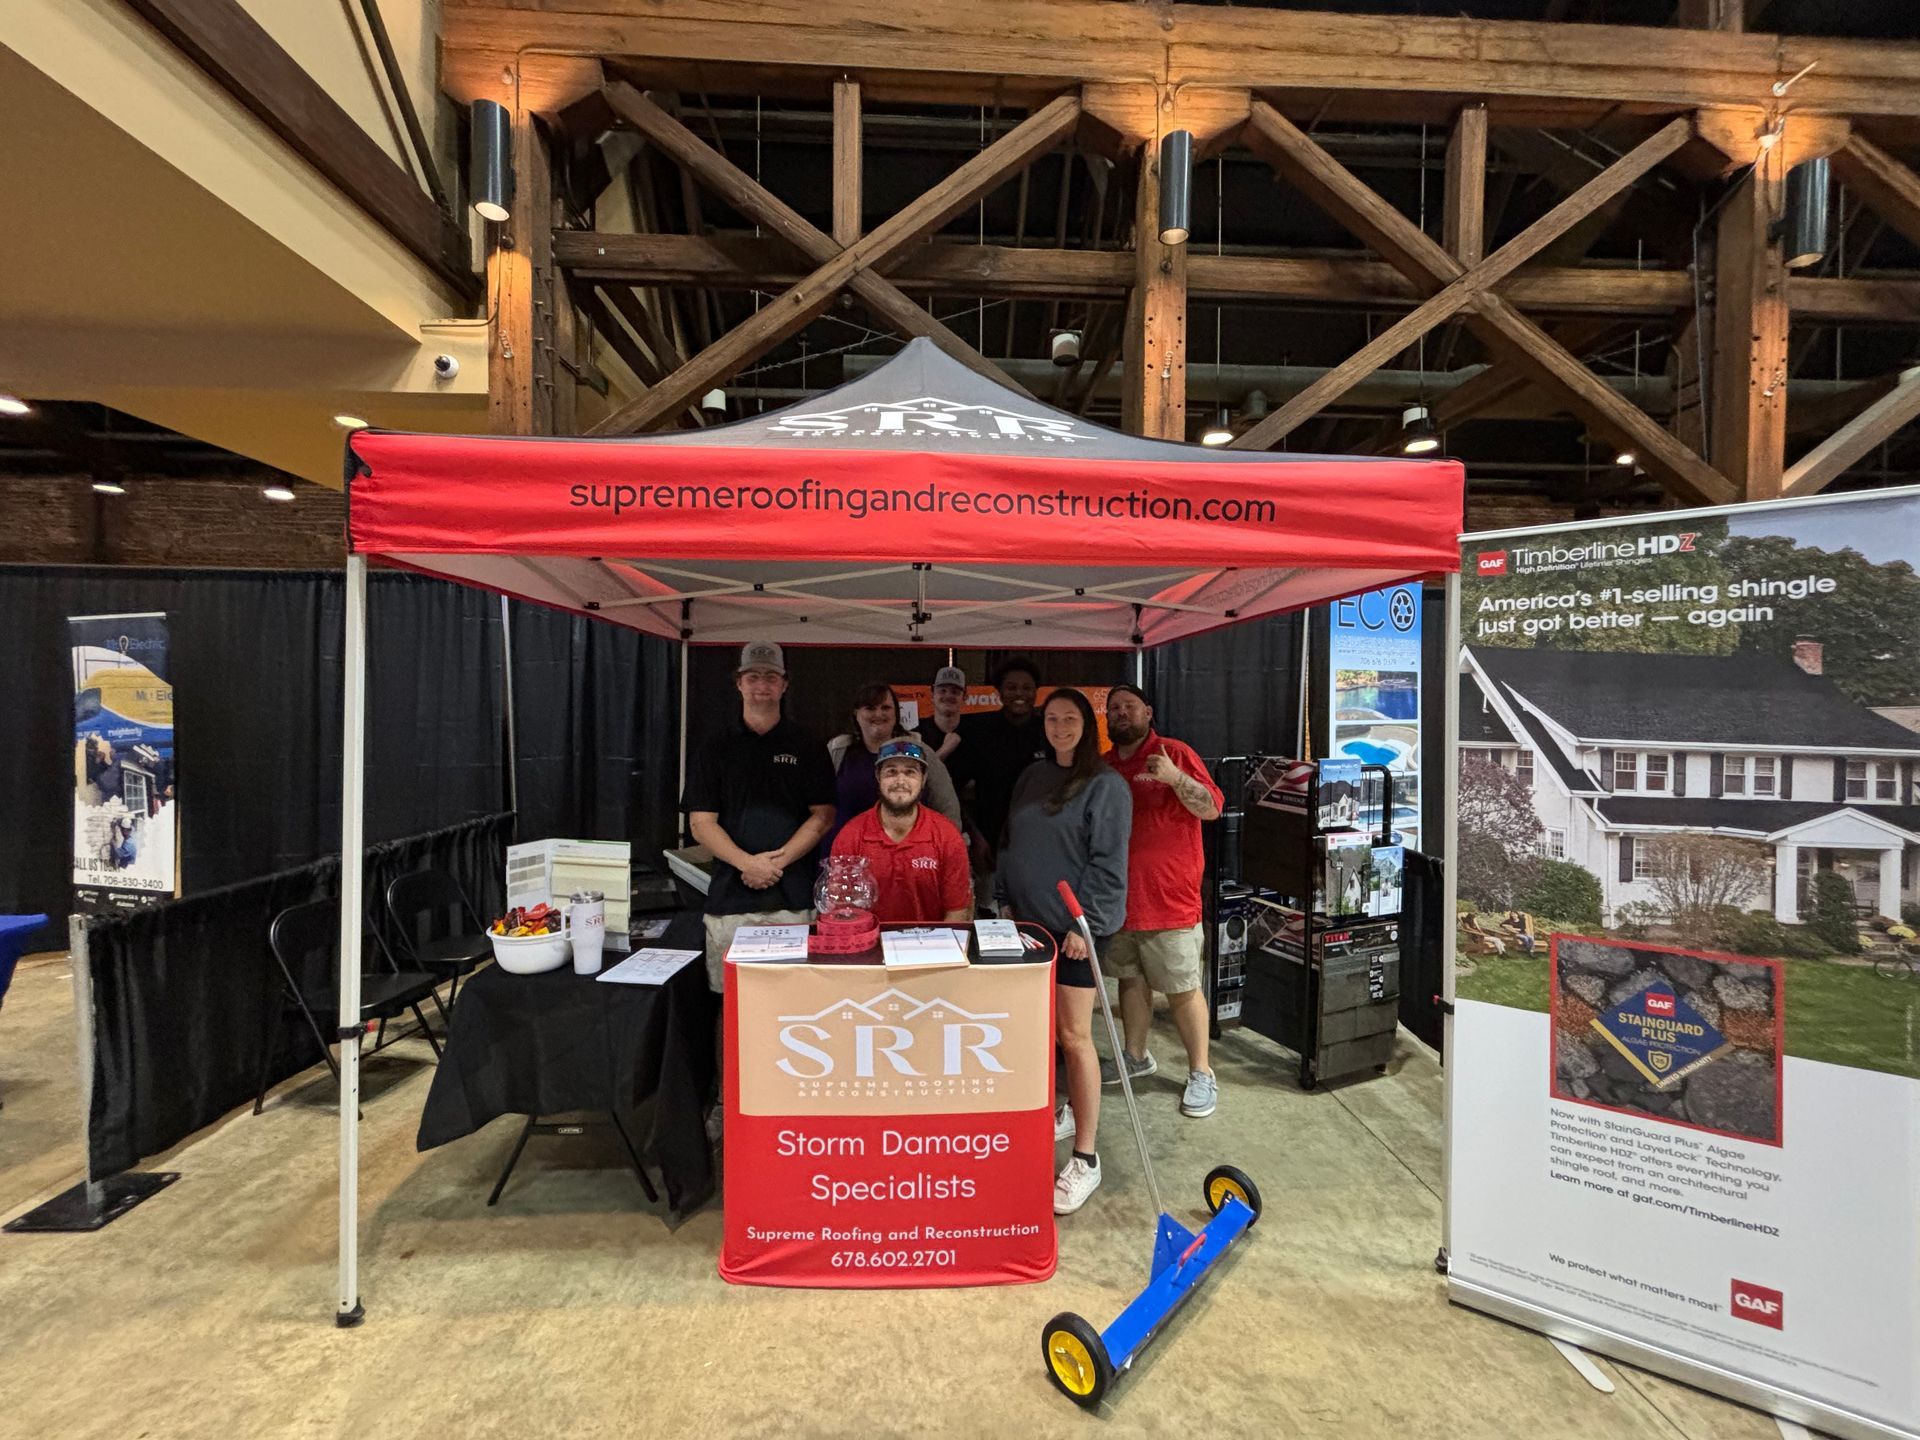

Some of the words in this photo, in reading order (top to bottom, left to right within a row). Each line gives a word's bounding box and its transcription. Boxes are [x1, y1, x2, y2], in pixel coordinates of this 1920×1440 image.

[767, 411, 1098, 440] SRR
[570, 479, 1275, 522] supremeroofingandreconstruction.com
[1480, 558, 1504, 569] GAF
[1512, 542, 1635, 566] Timberline
[1600, 584, 1718, 605] #1-selling
[1727, 575, 1837, 599] shingle
[1477, 616, 1516, 637] just
[1523, 614, 1562, 636] got
[1569, 611, 1644, 630] better
[1687, 604, 1773, 628] again
[773, 754, 798, 765] SRR
[912, 859, 938, 869] SRR
[103, 875, 164, 889] 706-530-3400
[1647, 999, 1673, 1010] GAF
[1618, 1012, 1704, 1036] STAINGUARD
[1642, 1028, 1676, 1043] PLUS
[776, 1023, 1014, 1078] SRR
[799, 1079, 890, 1089] SUPREME
[905, 1078, 995, 1088] ROOFING
[777, 1130, 865, 1156] Storm
[882, 1130, 1010, 1159] Damage
[1550, 1107, 1575, 1120] Now
[1578, 1116, 1601, 1127] with
[1604, 1121, 1671, 1144] StainGuard
[1707, 1145, 1746, 1160] Algae
[1550, 1131, 1608, 1153] Timberline
[1640, 1155, 1673, 1169] offers
[1676, 1163, 1742, 1187] everything
[1746, 1180, 1770, 1192] you
[1550, 1145, 1572, 1156] can
[1575, 1151, 1615, 1167] expect
[1618, 1161, 1644, 1174] from
[1647, 1170, 1664, 1180] an
[1667, 1174, 1748, 1200] architectural
[1610, 1136, 1634, 1147] and
[1705, 1156, 1782, 1182] Technology.
[810, 1173, 976, 1206] Specialists
[1550, 1156, 1590, 1172] shingle
[1622, 1175, 1645, 1187] and
[1649, 1183, 1683, 1197] more.
[1550, 1169, 1581, 1185] Learn
[1584, 1180, 1614, 1194] more
[1617, 1189, 1629, 1198] at
[1632, 1192, 1779, 1237] gaf.com/TimberlineHDZ
[746, 1226, 816, 1243] Supreme
[821, 1227, 882, 1244] Roofing
[889, 1227, 919, 1241] and
[925, 1223, 1039, 1240] Reconstruction
[831, 1250, 956, 1268] 678.602.2701
[1549, 1252, 1565, 1266] We
[1567, 1259, 1607, 1278] protect
[1609, 1272, 1638, 1287] what
[1640, 1283, 1685, 1302] matters
[1734, 1293, 1779, 1315] GAF
